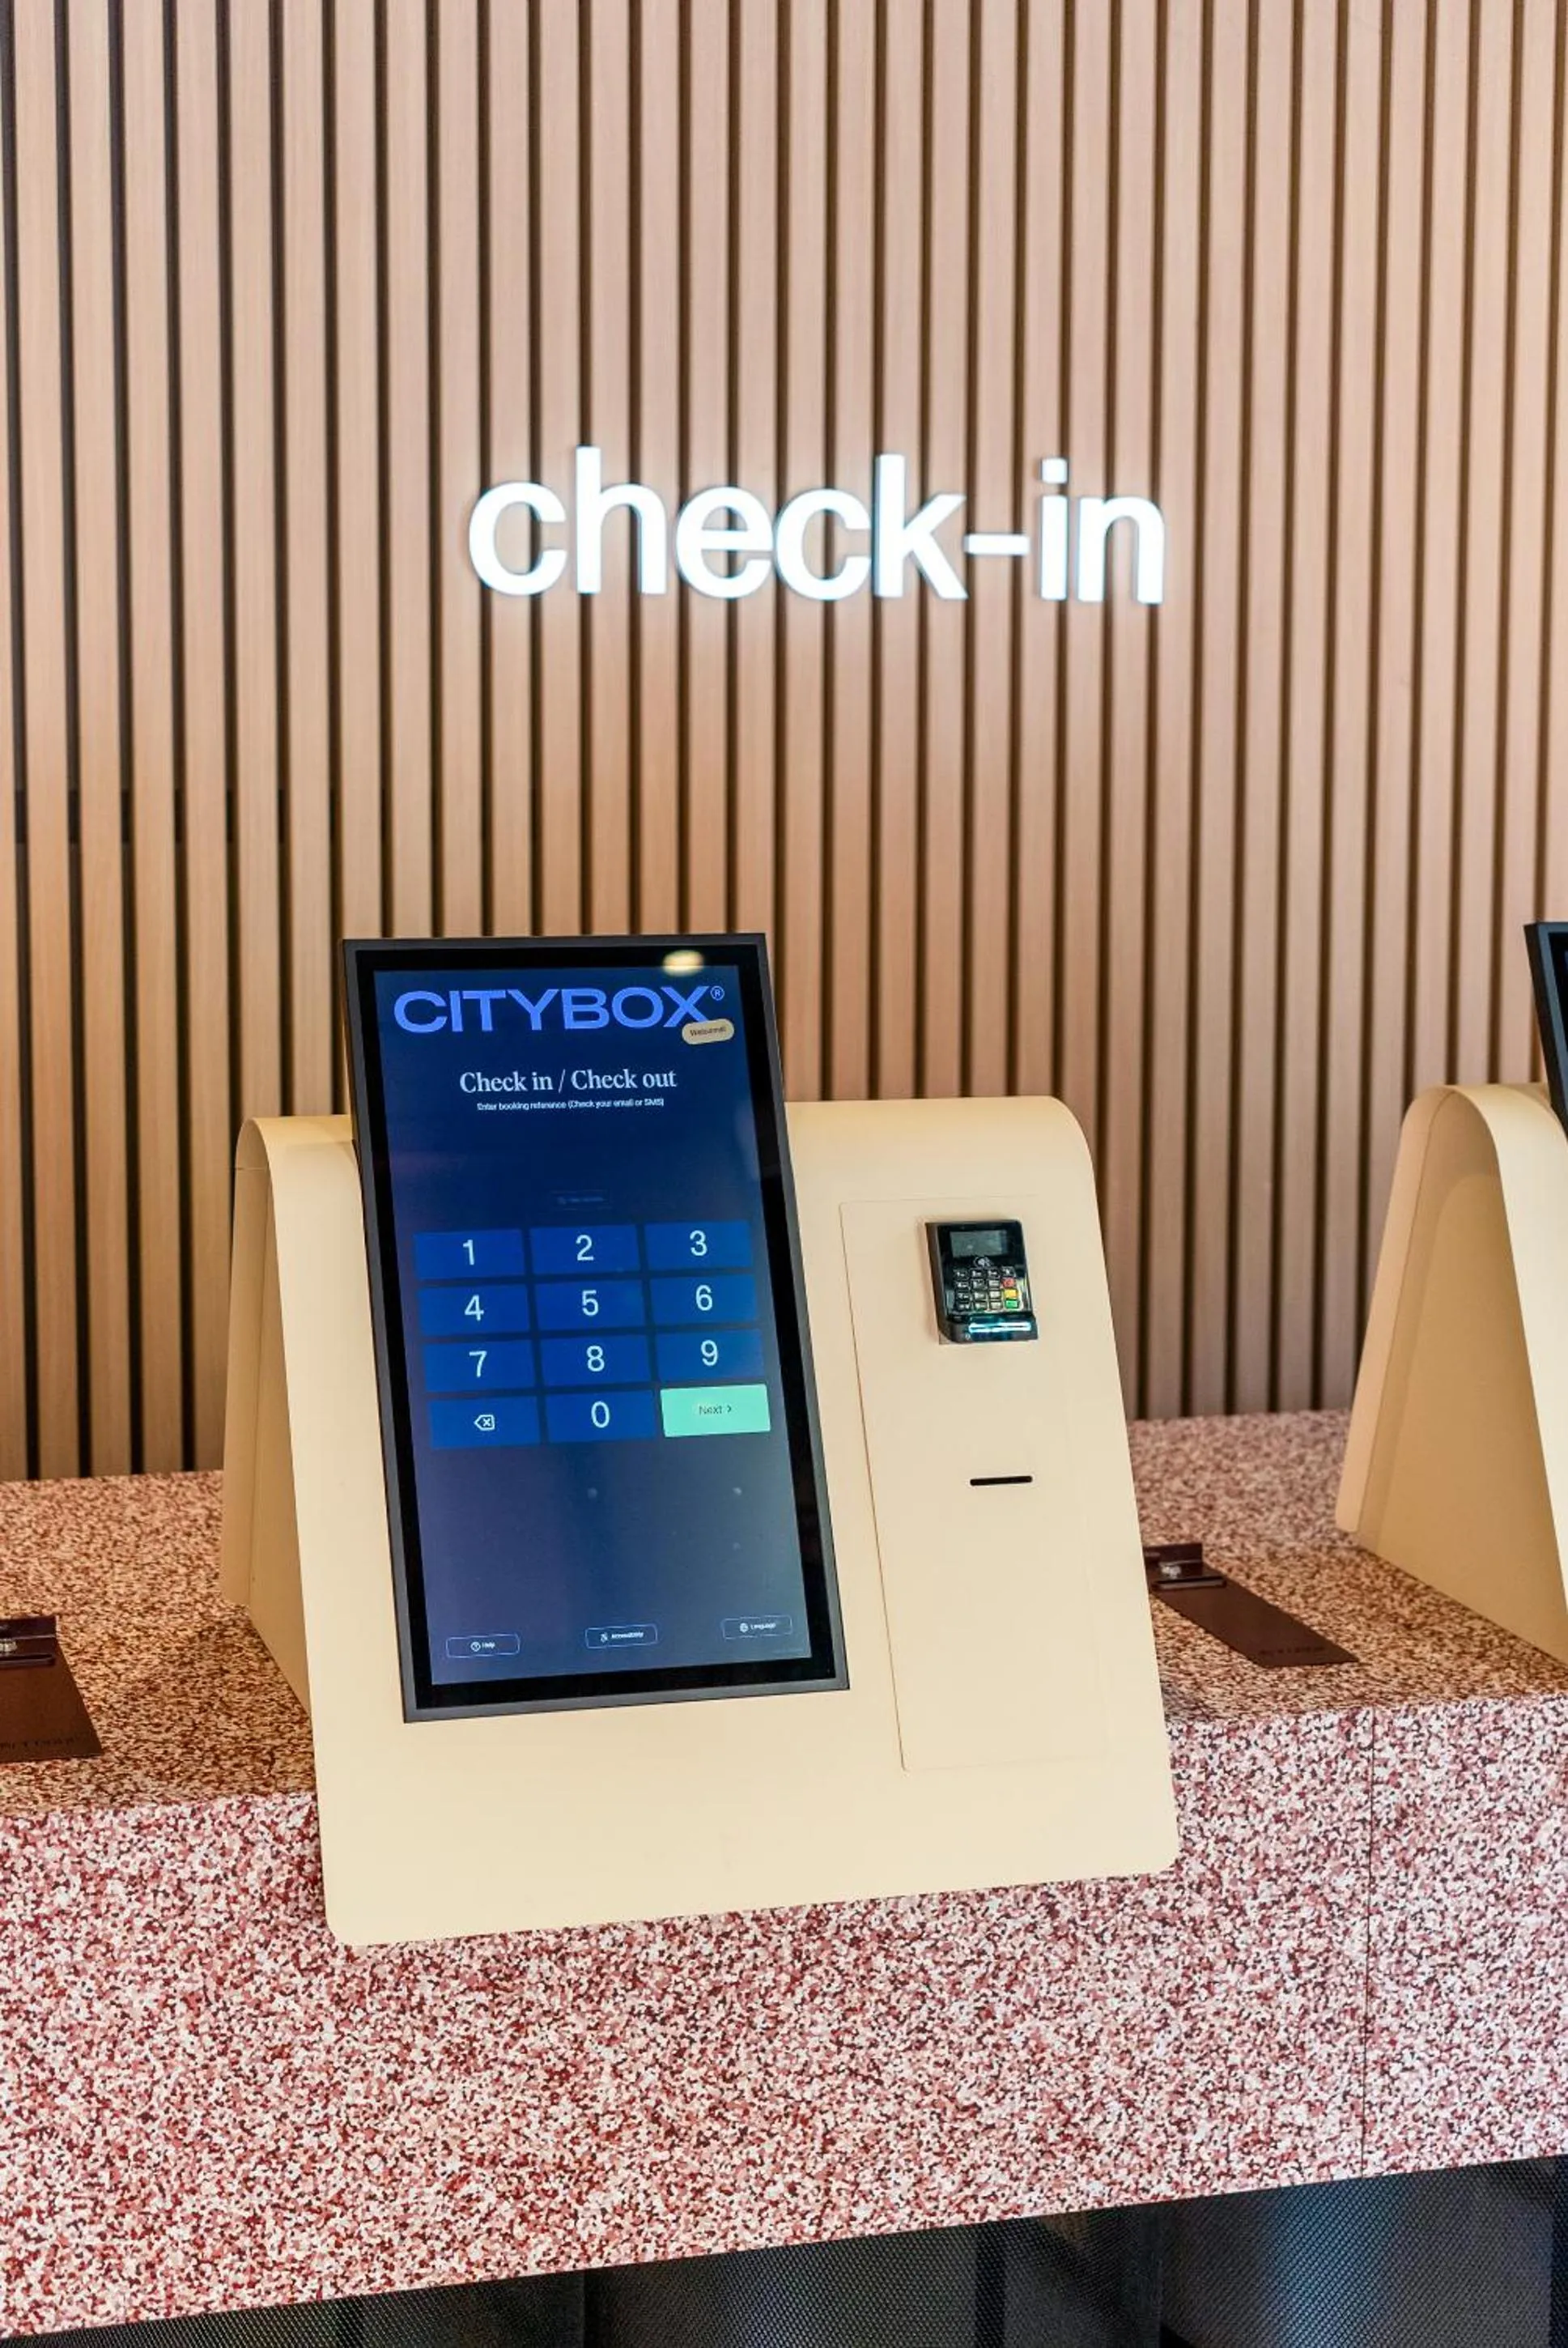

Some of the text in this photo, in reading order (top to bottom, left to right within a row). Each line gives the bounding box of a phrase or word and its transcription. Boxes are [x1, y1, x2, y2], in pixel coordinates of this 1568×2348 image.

[468, 445, 1166, 605] check-in
[459, 1070, 529, 1093] Check
[531, 1072, 554, 1091] in
[570, 1069, 638, 1090] Check
[642, 1070, 678, 1087] out
[498, 1101, 529, 1111] booking
[462, 1239, 476, 1265] 1
[575, 1234, 595, 1261] 2
[689, 1230, 708, 1257] 3
[464, 1294, 485, 1321] 4
[580, 1290, 599, 1316] 5
[695, 1284, 714, 1312] 6
[468, 1350, 488, 1378] 7
[585, 1345, 606, 1372] 8
[700, 1340, 719, 1367] 9
[590, 1401, 610, 1428] 0
[699, 1405, 722, 1415] Next
